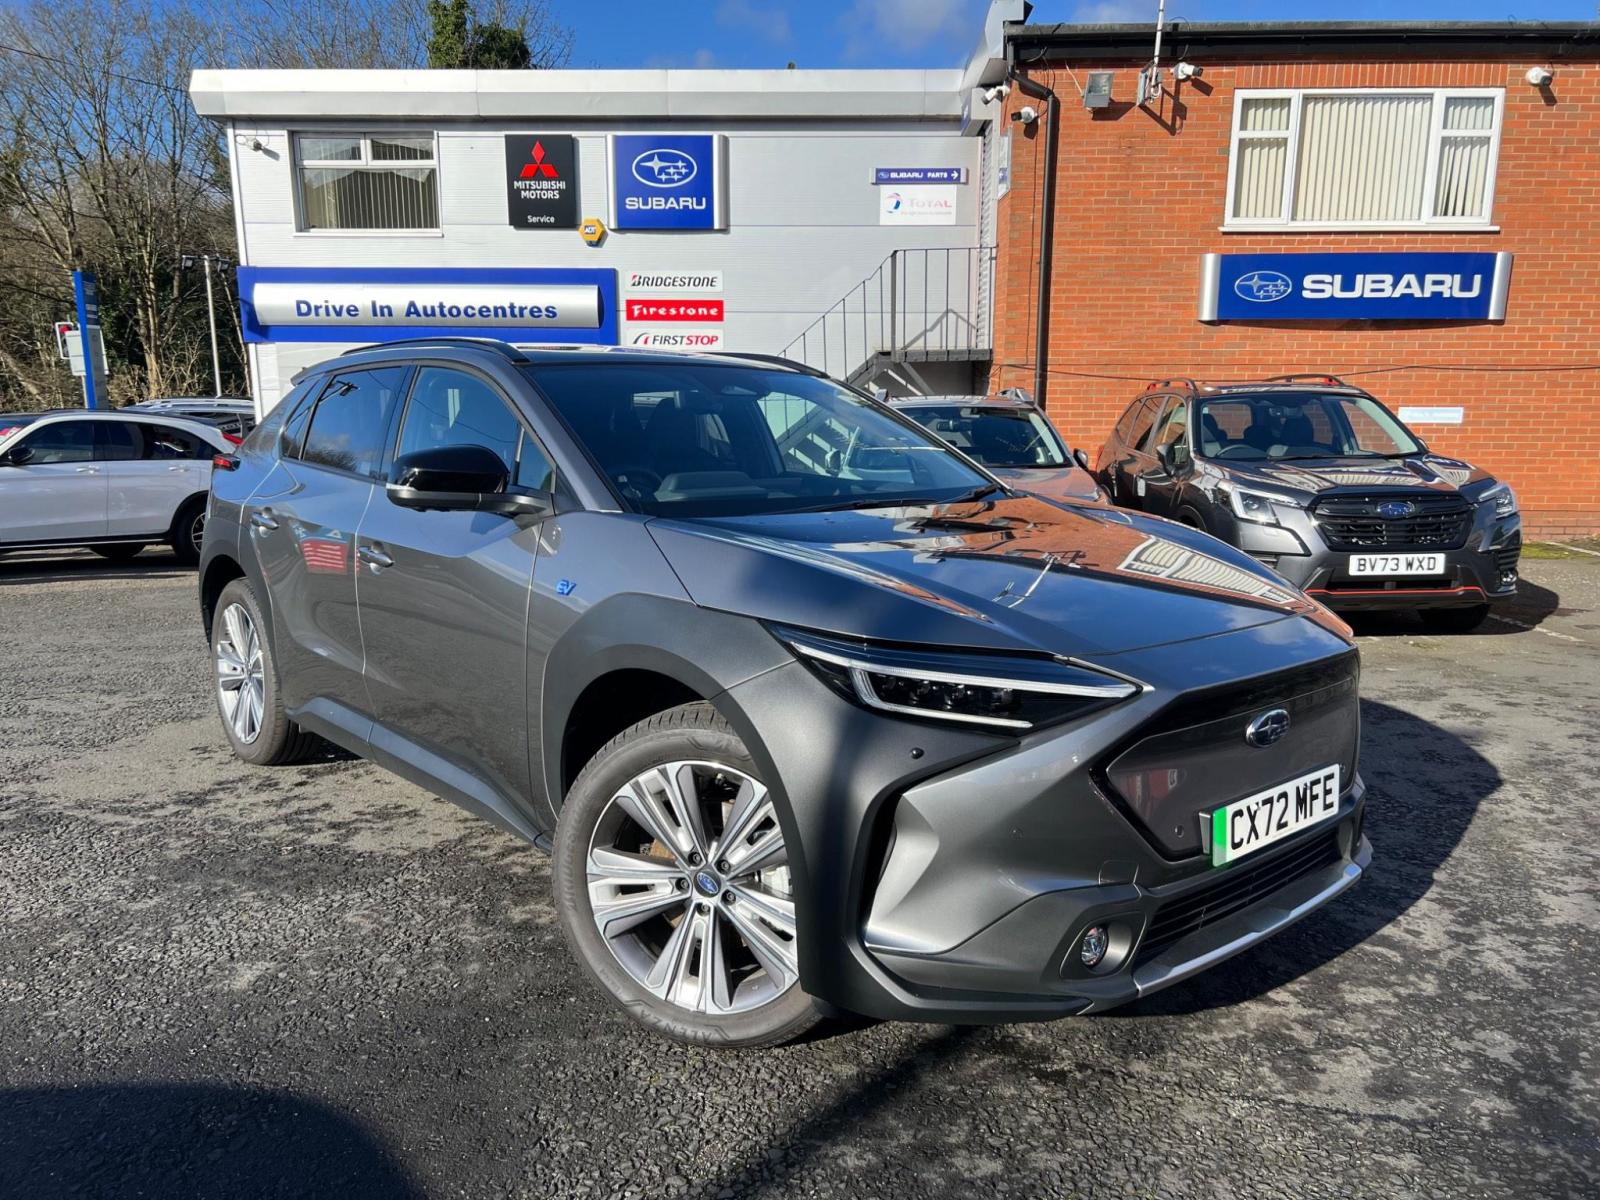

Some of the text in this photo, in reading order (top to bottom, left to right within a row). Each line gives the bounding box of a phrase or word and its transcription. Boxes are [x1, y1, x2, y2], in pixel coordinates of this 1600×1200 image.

[890, 171, 948, 179] SUBARU PARTS
[513, 180, 566, 190] MITSUBISHI
[520, 190, 560, 199] MOTORS
[625, 197, 706, 210] SUBARU
[909, 198, 953, 208] TOTAL
[527, 215, 555, 223] Service
[631, 274, 718, 288] BRIDGESTONE
[1302, 274, 1482, 299] SUBARU
[295, 299, 558, 319] Drive In Autocentres
[631, 304, 719, 318] Firestone
[1357, 556, 1437, 572] BV73 WXD
[1230, 772, 1335, 850] CX72 MFE
